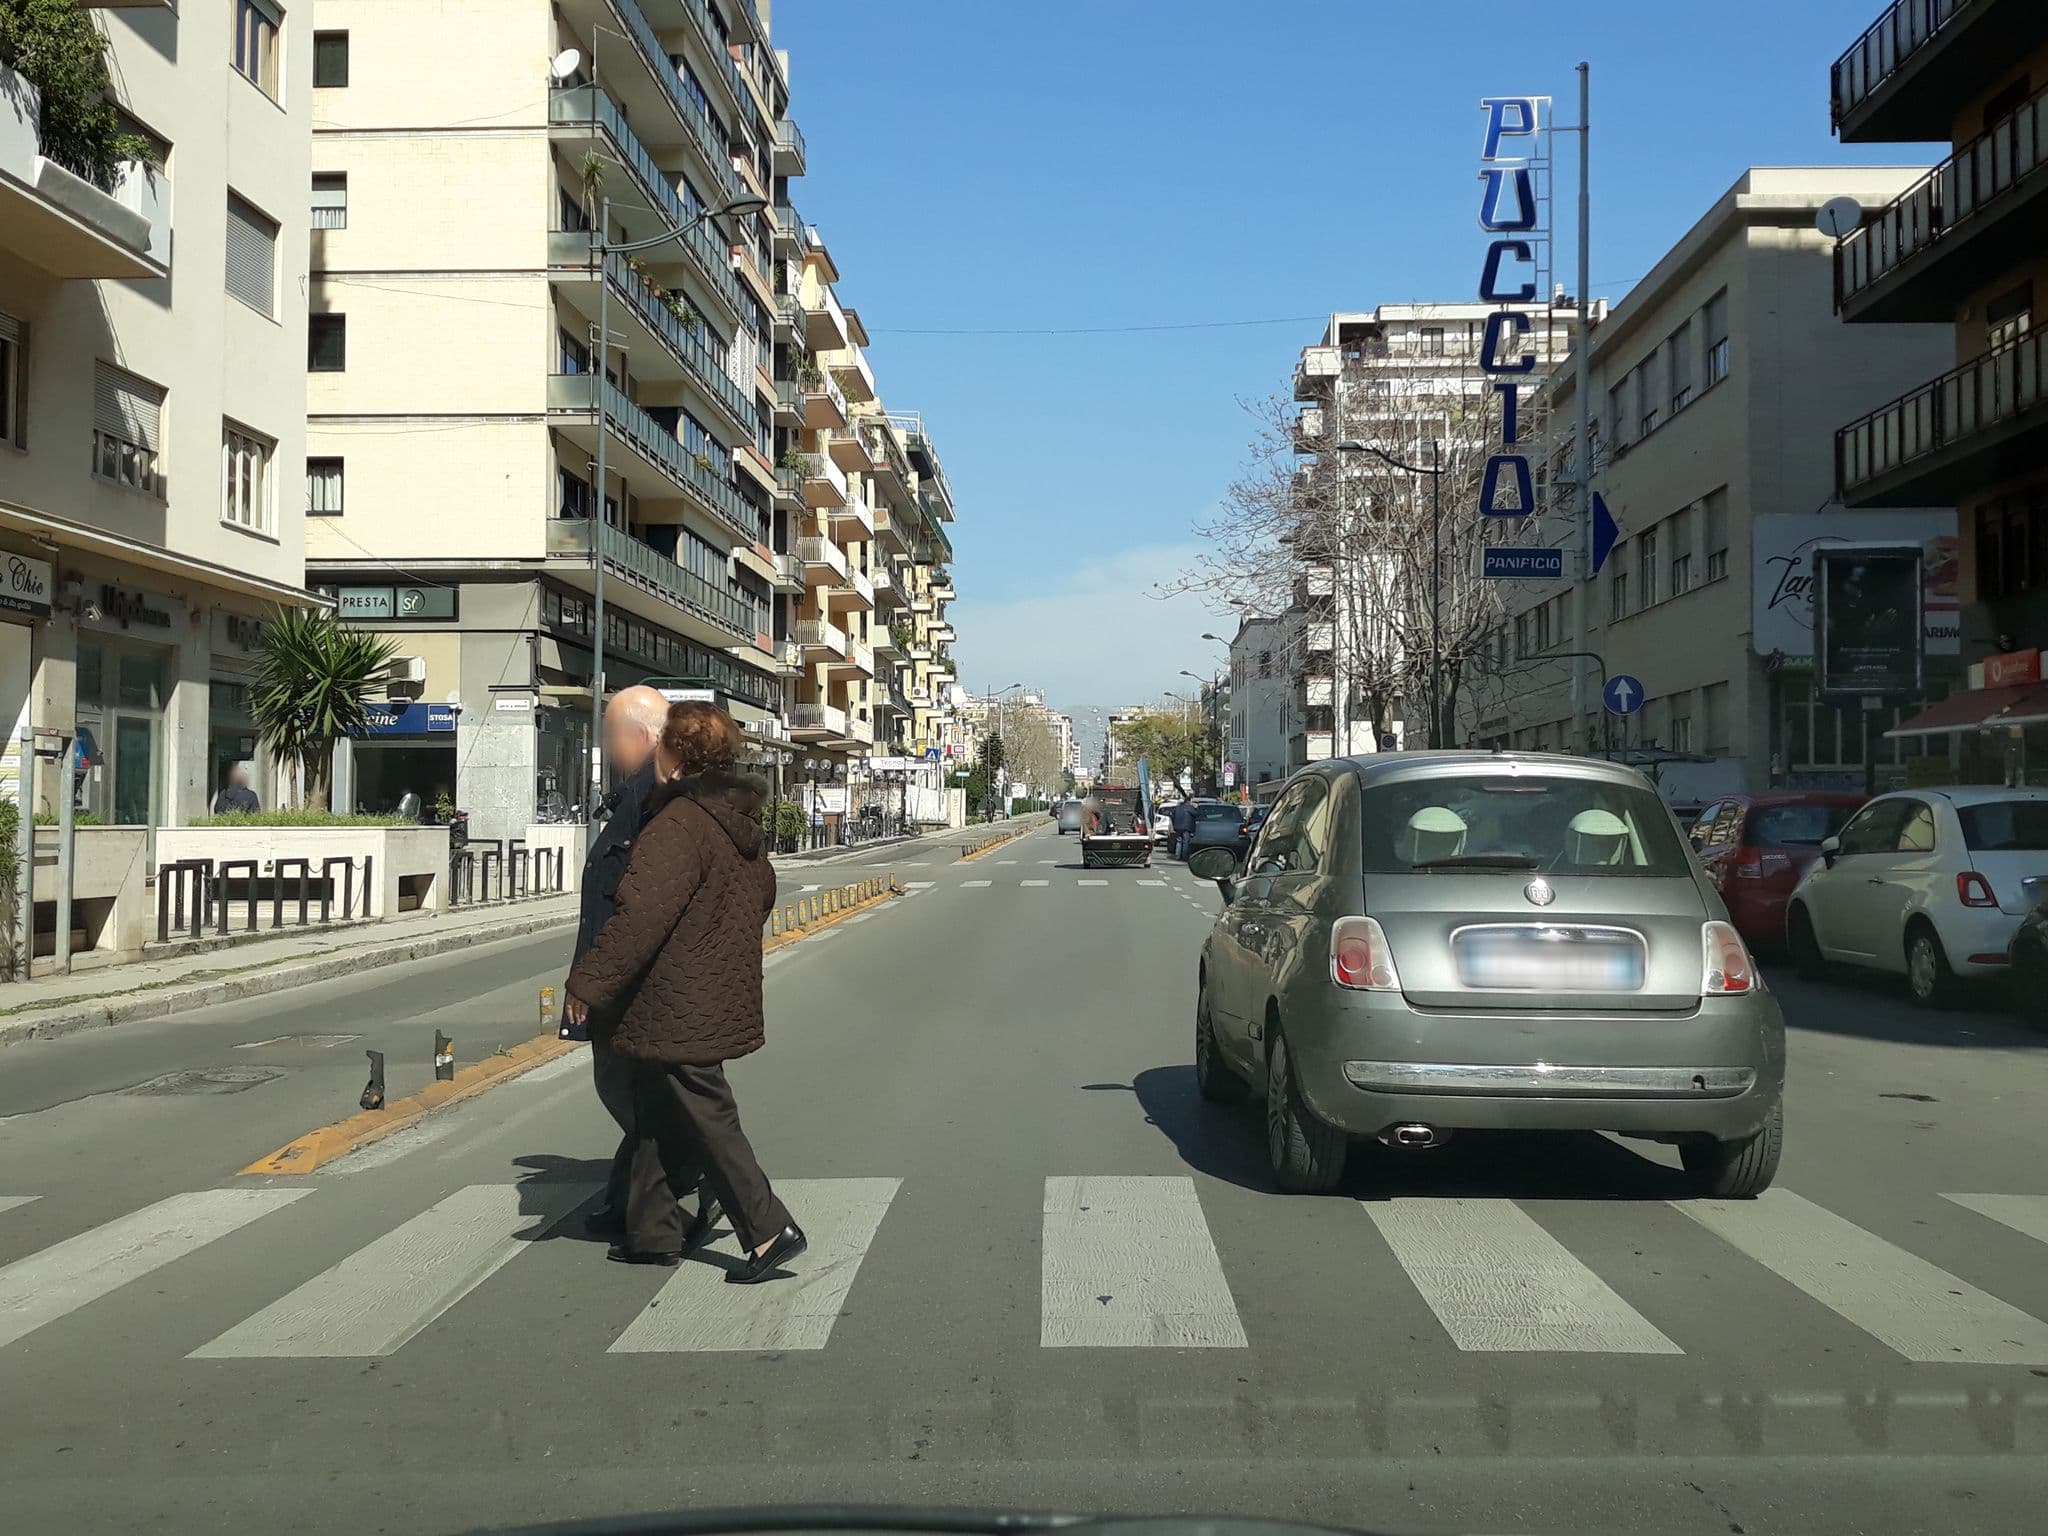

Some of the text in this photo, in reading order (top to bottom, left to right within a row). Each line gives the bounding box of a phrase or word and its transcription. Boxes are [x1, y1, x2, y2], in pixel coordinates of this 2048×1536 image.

[1485, 556, 1560, 569] PANIFICIO
[342, 596, 388, 608] PRESTA
[428, 714, 453, 722] STOSA
